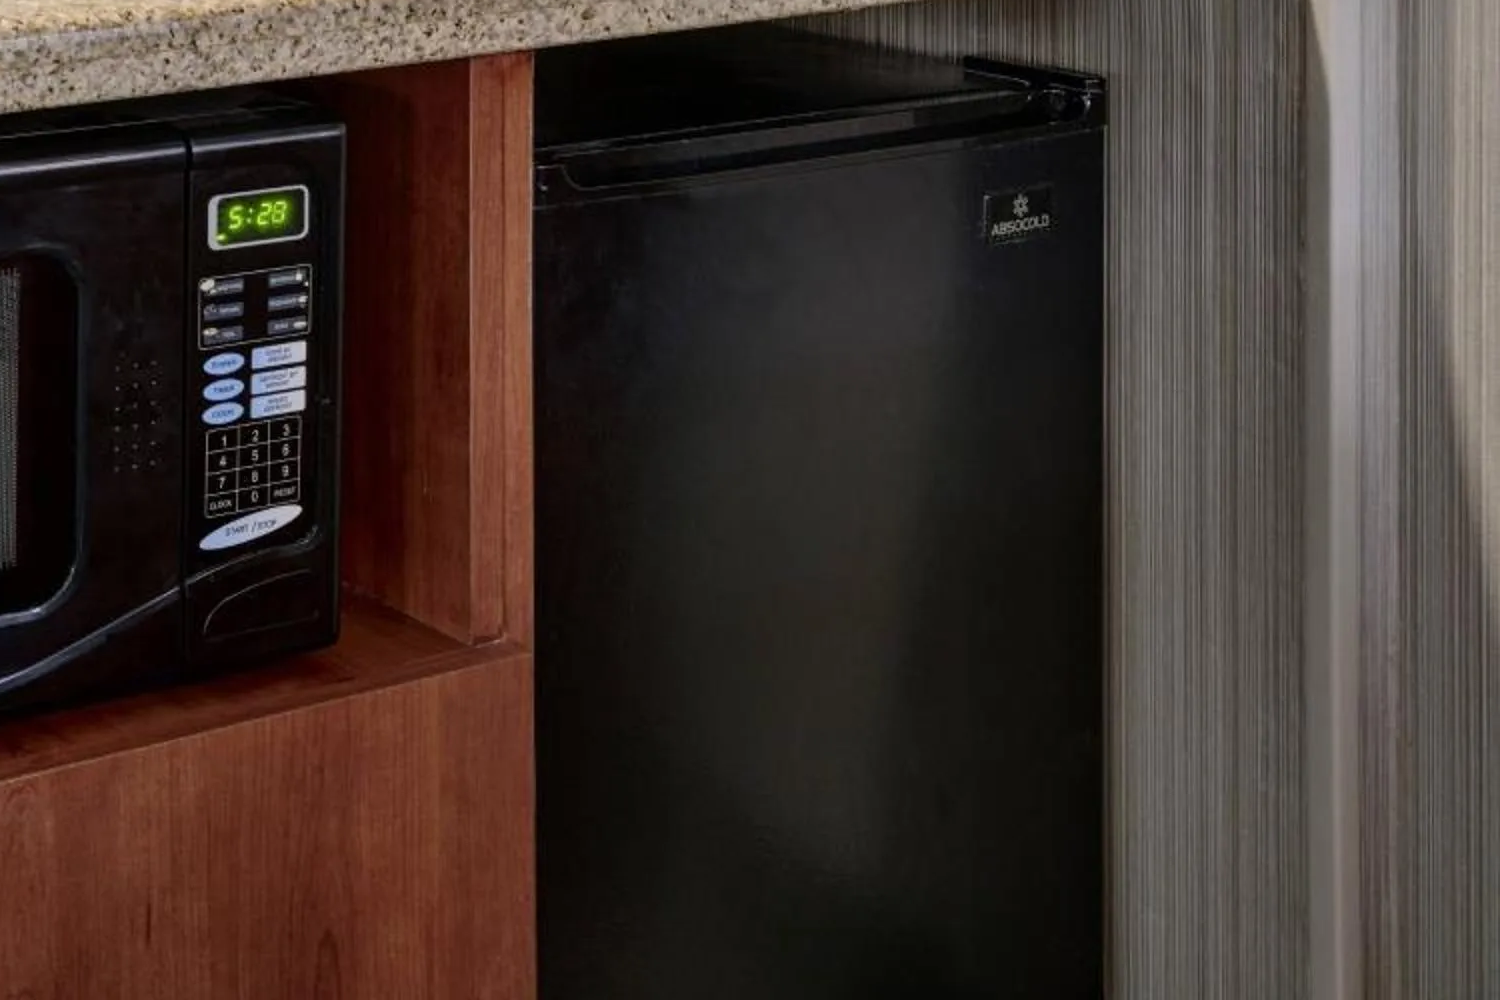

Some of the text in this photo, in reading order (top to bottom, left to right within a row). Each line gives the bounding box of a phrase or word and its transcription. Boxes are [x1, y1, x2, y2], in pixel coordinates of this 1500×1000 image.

[229, 201, 287, 229] 5:28
[991, 214, 1050, 236] ABSOCOLD
[221, 423, 291, 448] 1 2 3
[219, 443, 290, 467] 4 5 6
[218, 464, 290, 489] 7 8 9
[251, 489, 260, 503] 0
